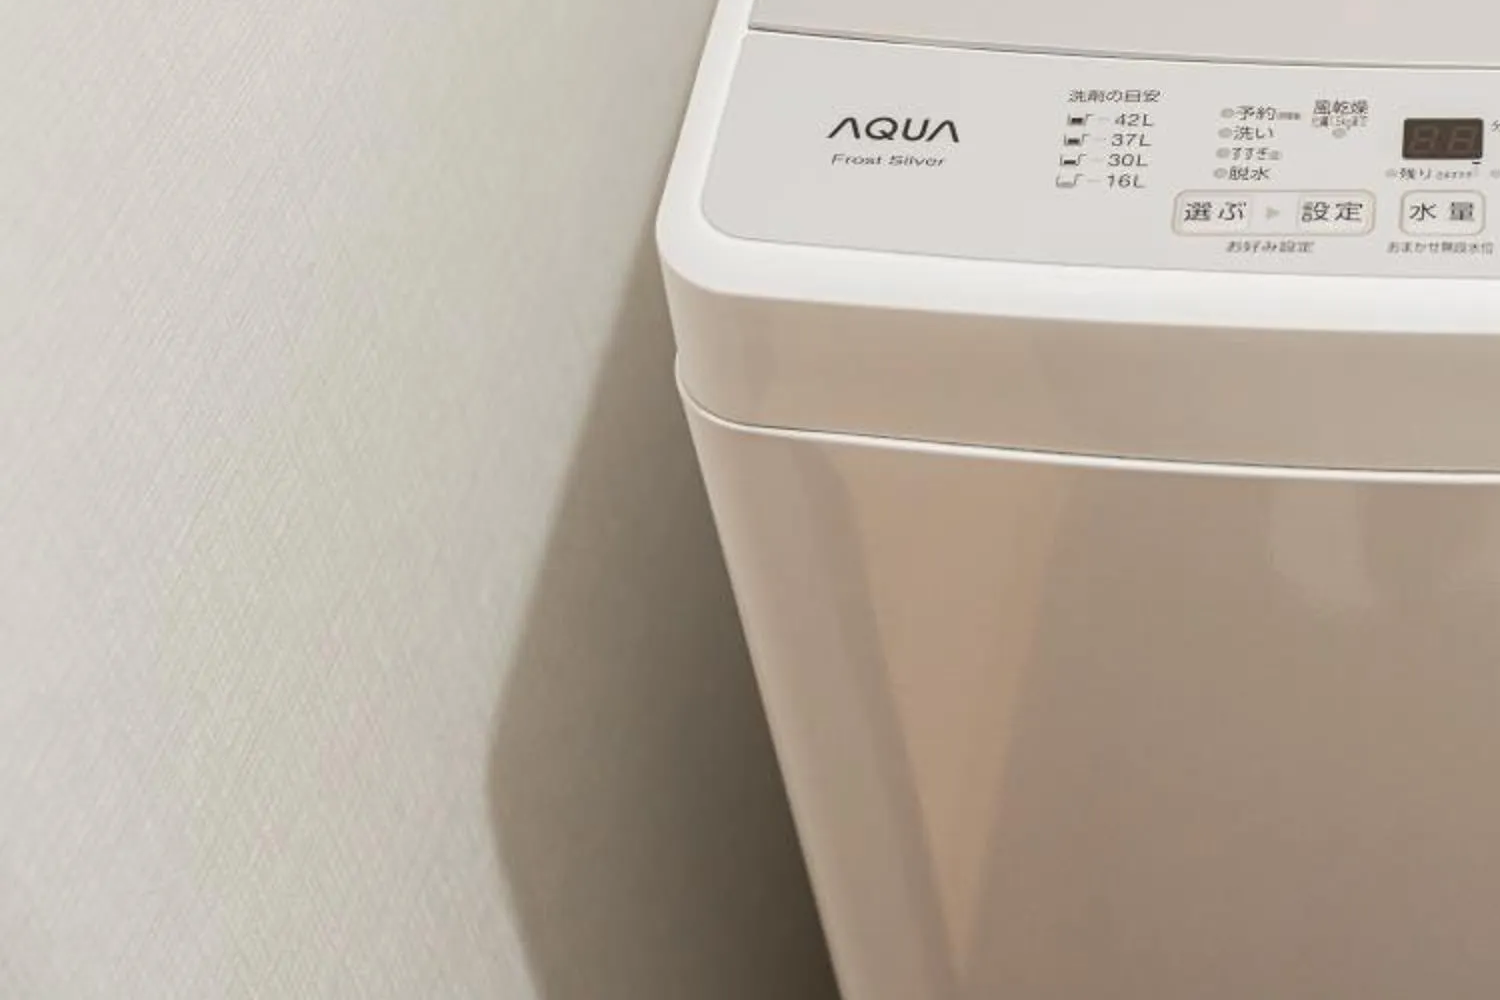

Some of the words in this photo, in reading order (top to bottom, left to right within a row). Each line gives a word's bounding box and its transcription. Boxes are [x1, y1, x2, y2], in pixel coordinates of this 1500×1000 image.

[1114, 113, 1155, 127] 42L
[1239, 105, 1277, 121] 予約
[826, 116, 960, 143] AQUA
[1232, 126, 1276, 141] 洗い
[1111, 133, 1152, 147] 37L
[831, 153, 882, 166] Frost
[889, 154, 946, 167] Silver
[1107, 153, 1149, 167] 30L
[1107, 173, 1146, 189] 16L
[1228, 166, 1271, 181] 脱水
[1183, 202, 1247, 222] 選ぶ
[1301, 202, 1363, 222] 設定
[1409, 201, 1475, 221] 水量
